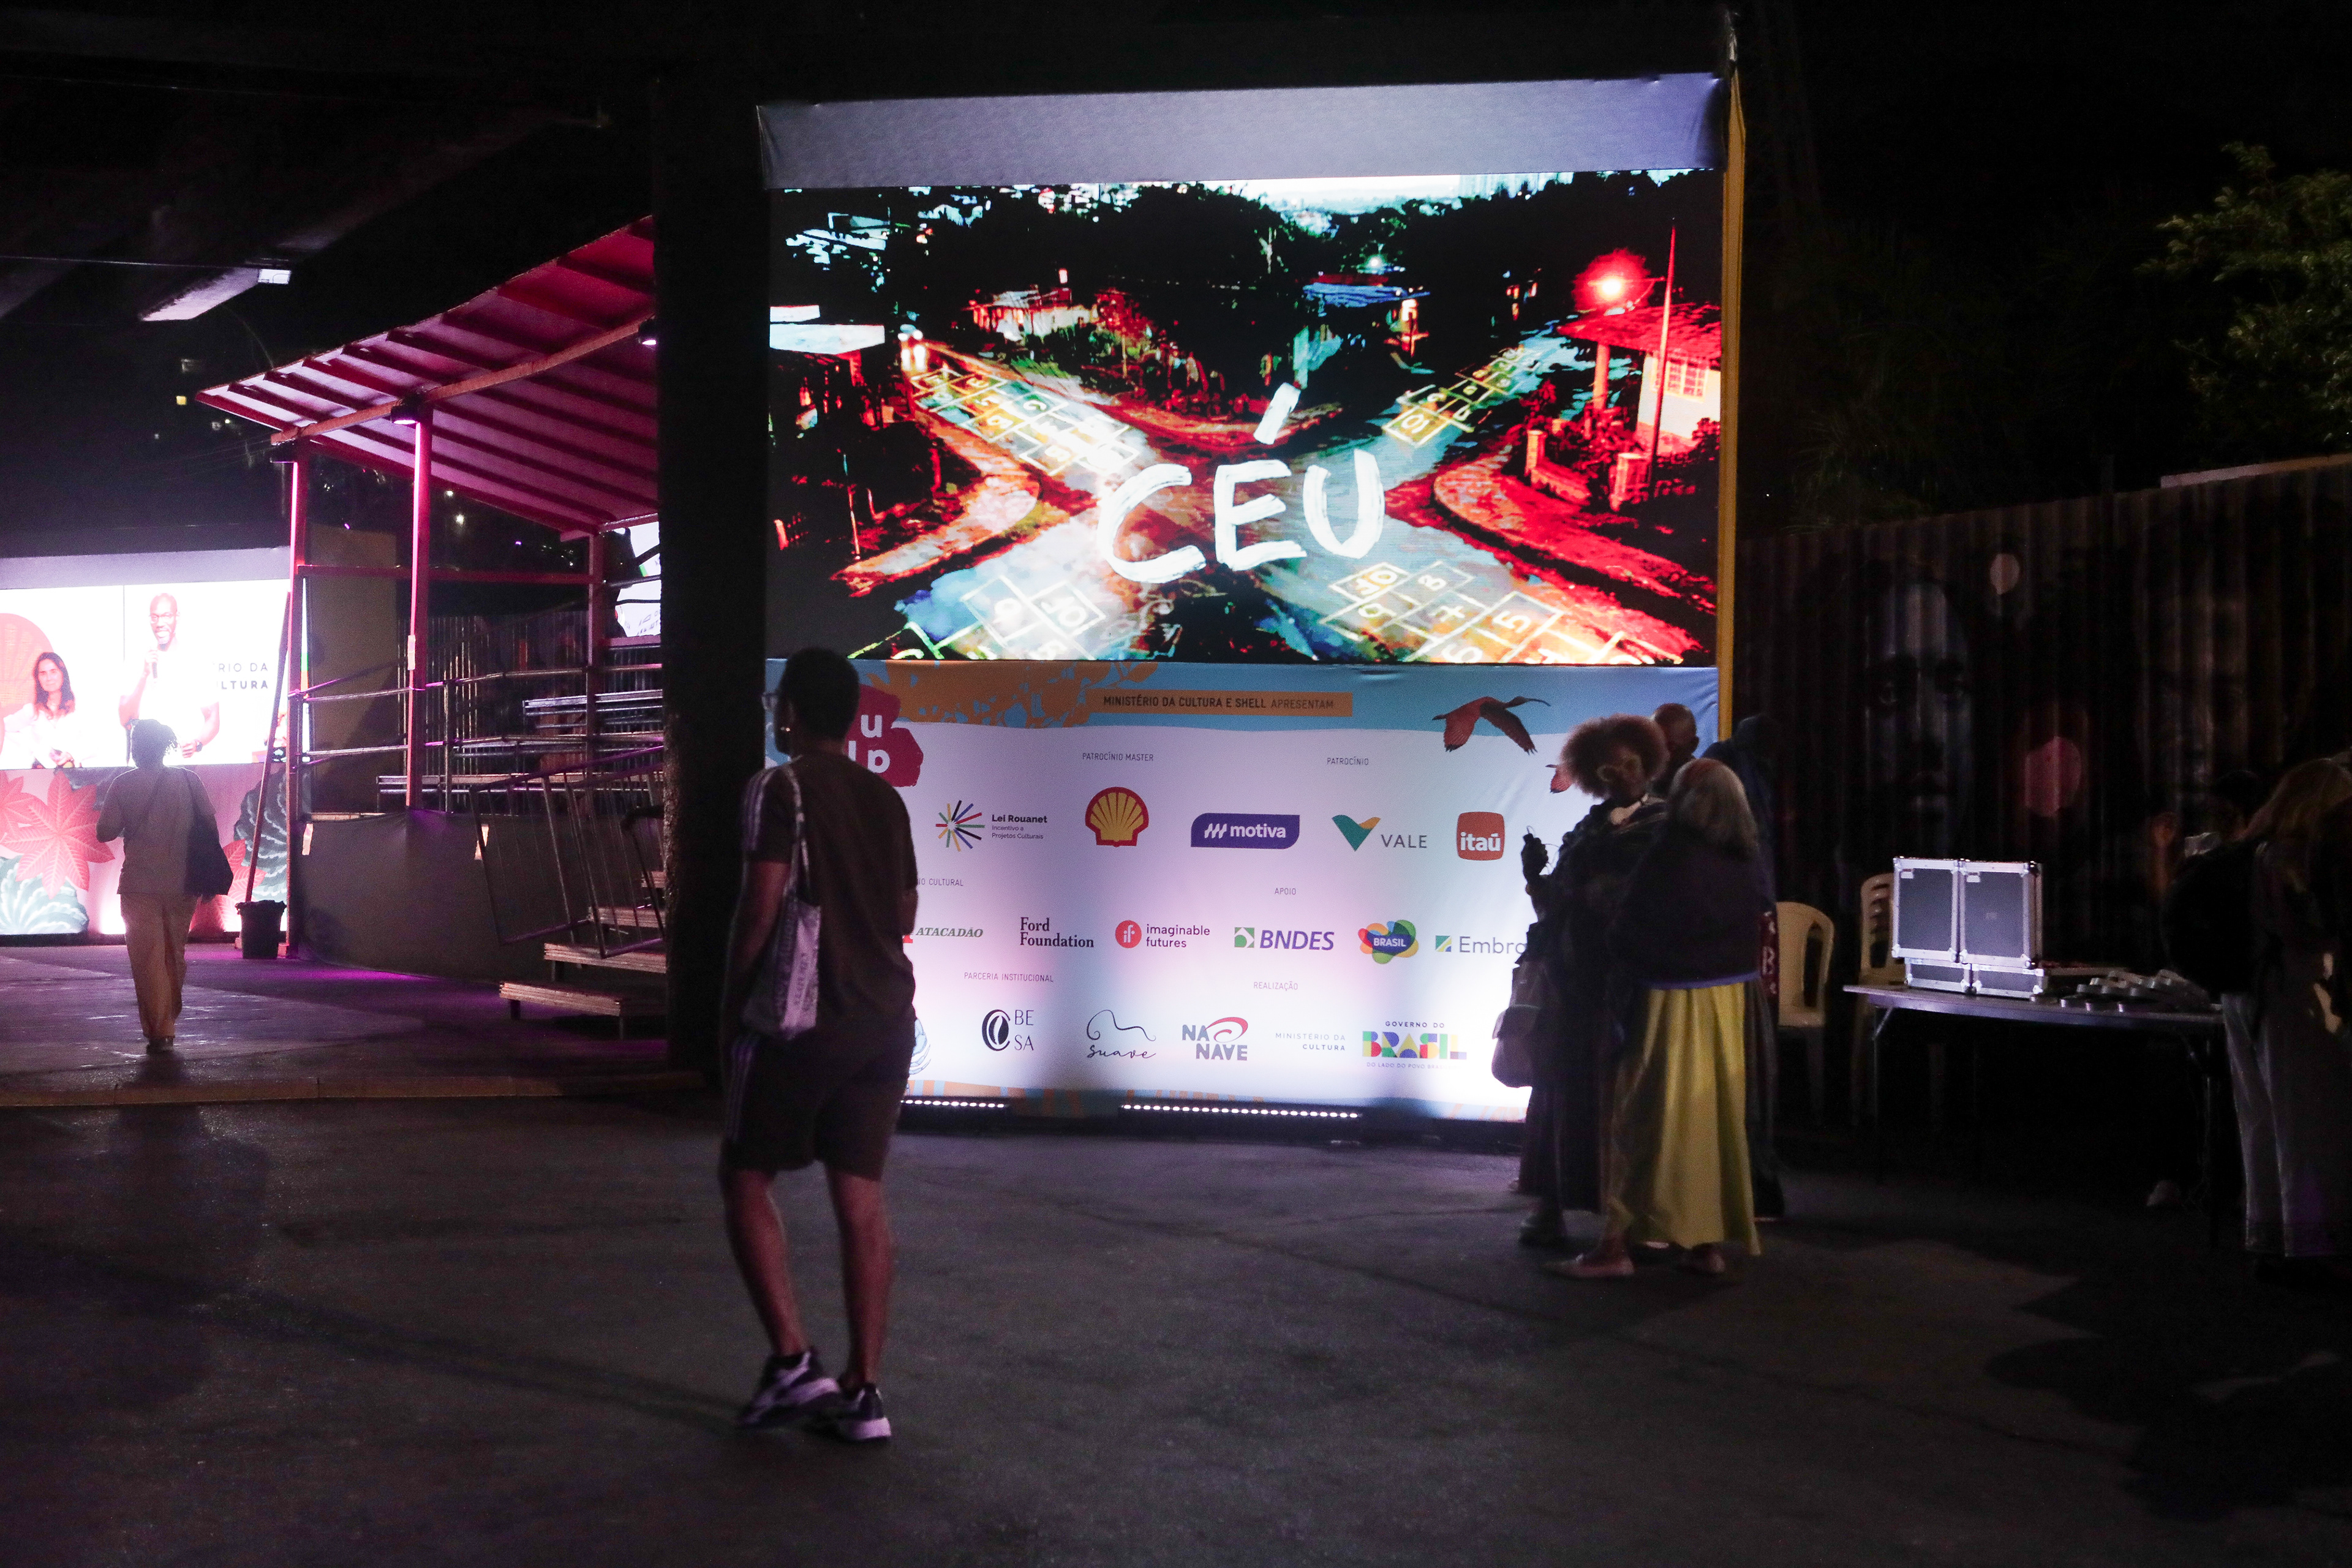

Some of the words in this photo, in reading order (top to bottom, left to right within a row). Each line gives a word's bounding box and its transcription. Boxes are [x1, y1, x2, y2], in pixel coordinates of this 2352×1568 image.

[1098, 383, 1385, 583] CÉU
[212, 663, 242, 673] RIO
[250, 663, 268, 671] DA
[216, 680, 268, 690] LTURA
[1103, 695, 1159, 706] MINISTÉRIO
[1162, 697, 1176, 707] DA
[1178, 697, 1223, 707] CULTURA
[1226, 698, 1232, 707] E
[1235, 698, 1266, 708] SHELL
[1271, 699, 1334, 709] APRESENTAM
[1082, 751, 1123, 762] PATROCÍNIO
[1126, 753, 1154, 762] MASTER
[1327, 755, 1370, 766] PATROCÍNIO
[1008, 815, 1047, 823] Rouanet
[1230, 823, 1286, 839] motiva
[1381, 834, 1427, 849] VALE
[1460, 831, 1501, 852] itaú
[1274, 887, 1297, 895] APOIO
[1020, 917, 1050, 932] Ford
[1146, 924, 1210, 937] imaginable
[916, 926, 984, 938] ATACADÃO
[1020, 932, 1095, 948] Foundation
[1146, 936, 1187, 948] futures
[1260, 930, 1335, 951] BNDES
[1373, 937, 1406, 948] BRASIL
[1460, 936, 1526, 954] Embra
[1001, 973, 1054, 982] INSTITUCIONAL
[1253, 981, 1298, 992] REALIZAÇÃO
[1014, 1009, 1034, 1026] BE
[1182, 1024, 1210, 1042] NA
[1275, 1031, 1331, 1041] MINISTÉRIO
[1014, 1035, 1034, 1051] SA
[1362, 1031, 1467, 1060] BRASIL
[1196, 1044, 1248, 1061] NAVE
